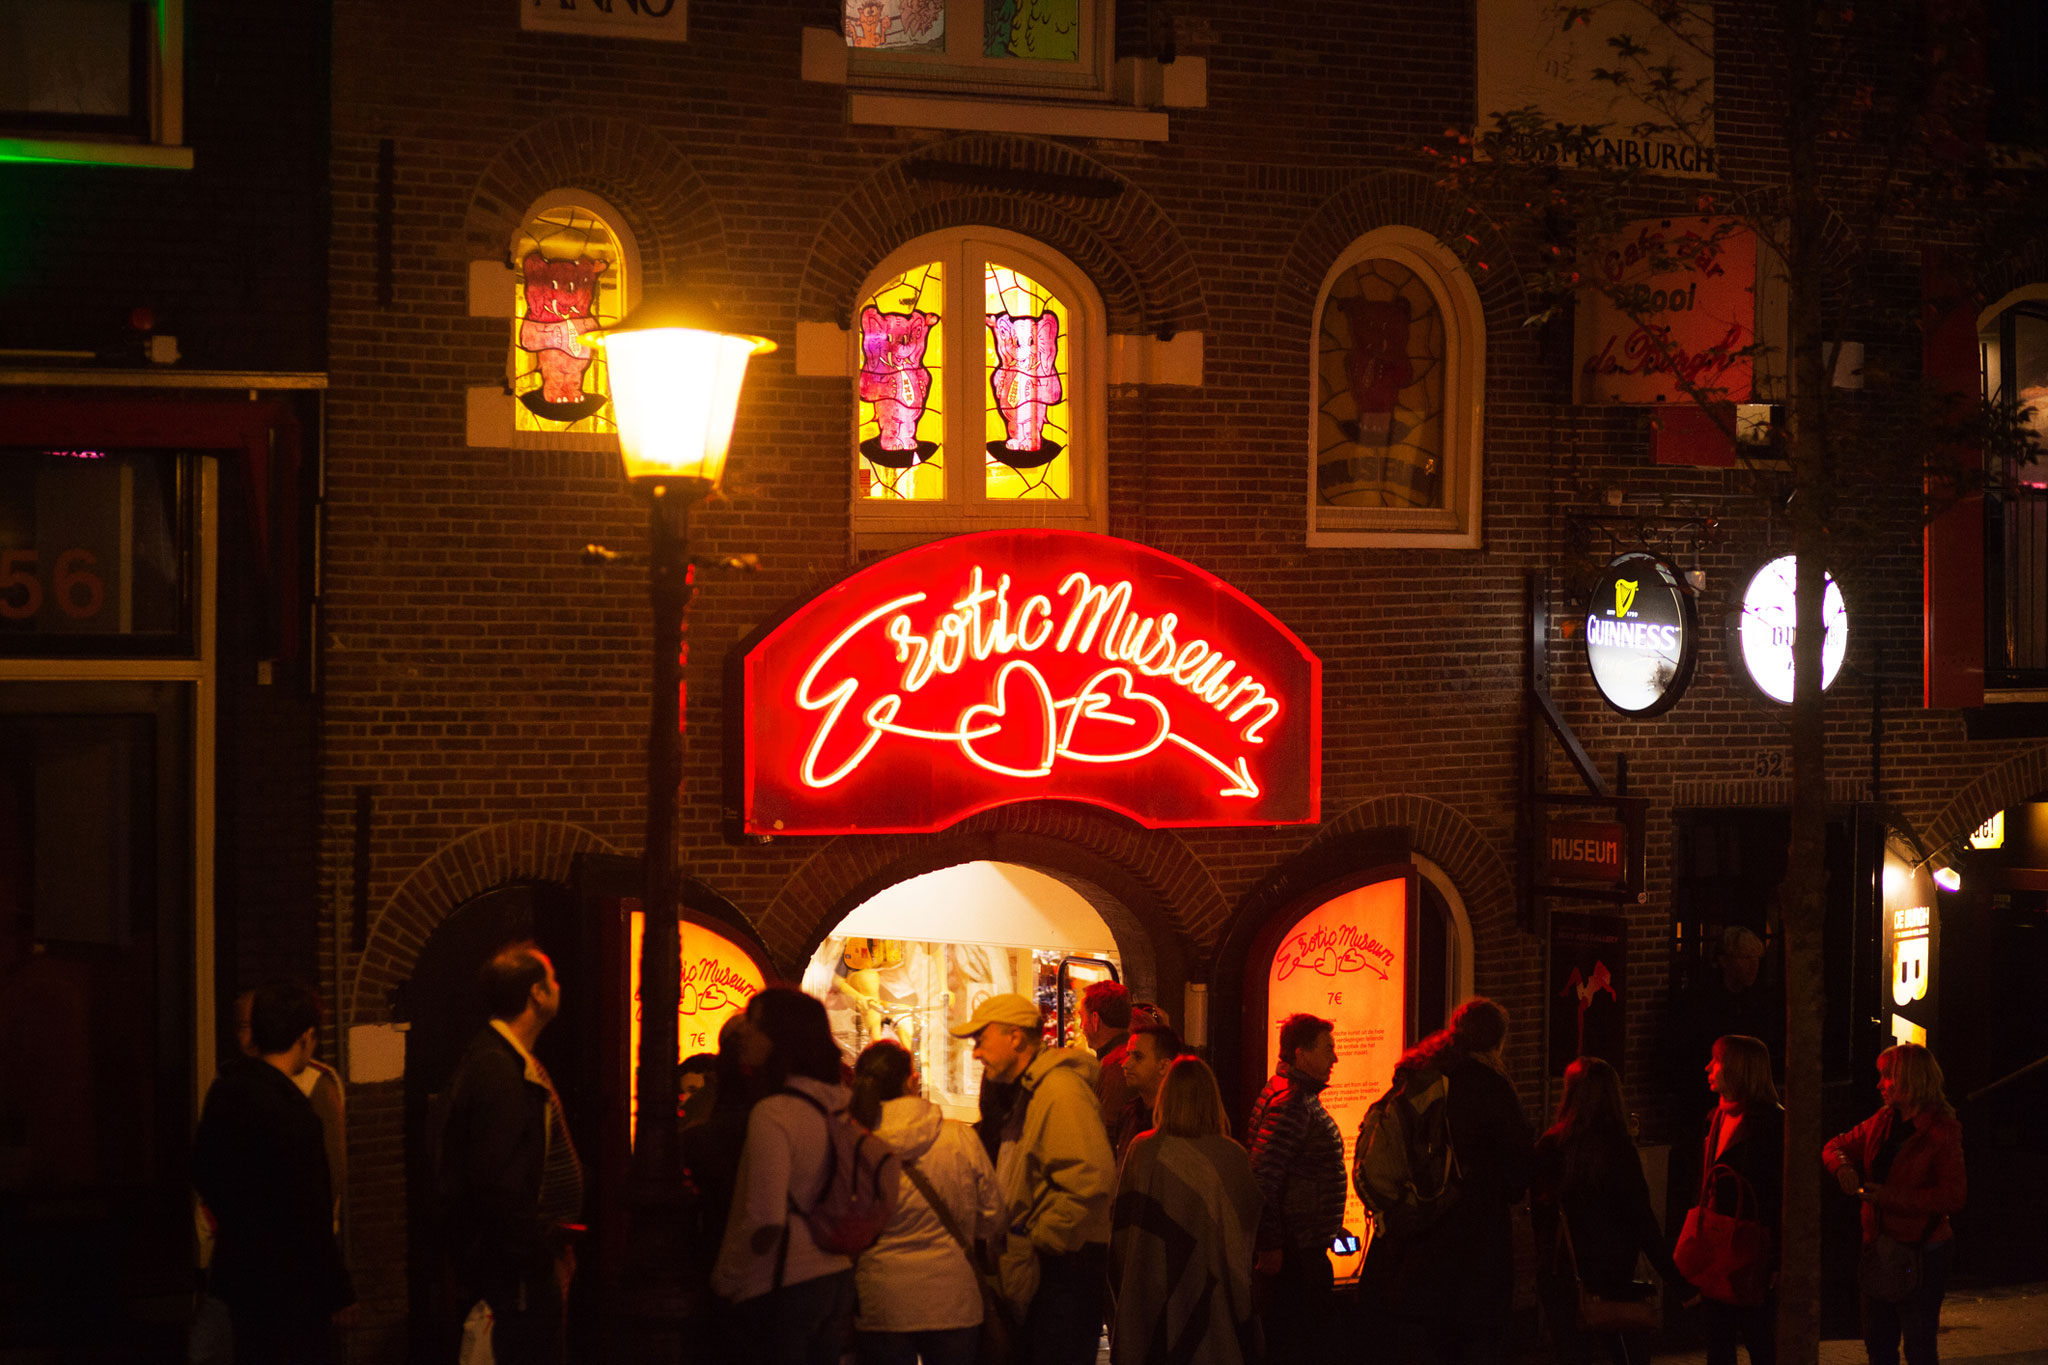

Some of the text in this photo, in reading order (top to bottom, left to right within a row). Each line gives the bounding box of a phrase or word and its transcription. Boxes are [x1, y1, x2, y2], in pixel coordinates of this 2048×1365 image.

[1582, 335, 1618, 376] de
[0, 548, 105, 619] 56
[1586, 614, 1677, 651] GUINNESS
[796, 565, 1280, 788] Erotic Museum
[1757, 751, 1782, 777] 52
[1551, 837, 1618, 865] MUSEUM
[1276, 924, 1395, 981] Erotic Museum
[1327, 991, 1343, 1005] 7€
[690, 1032, 706, 1047] 7€
